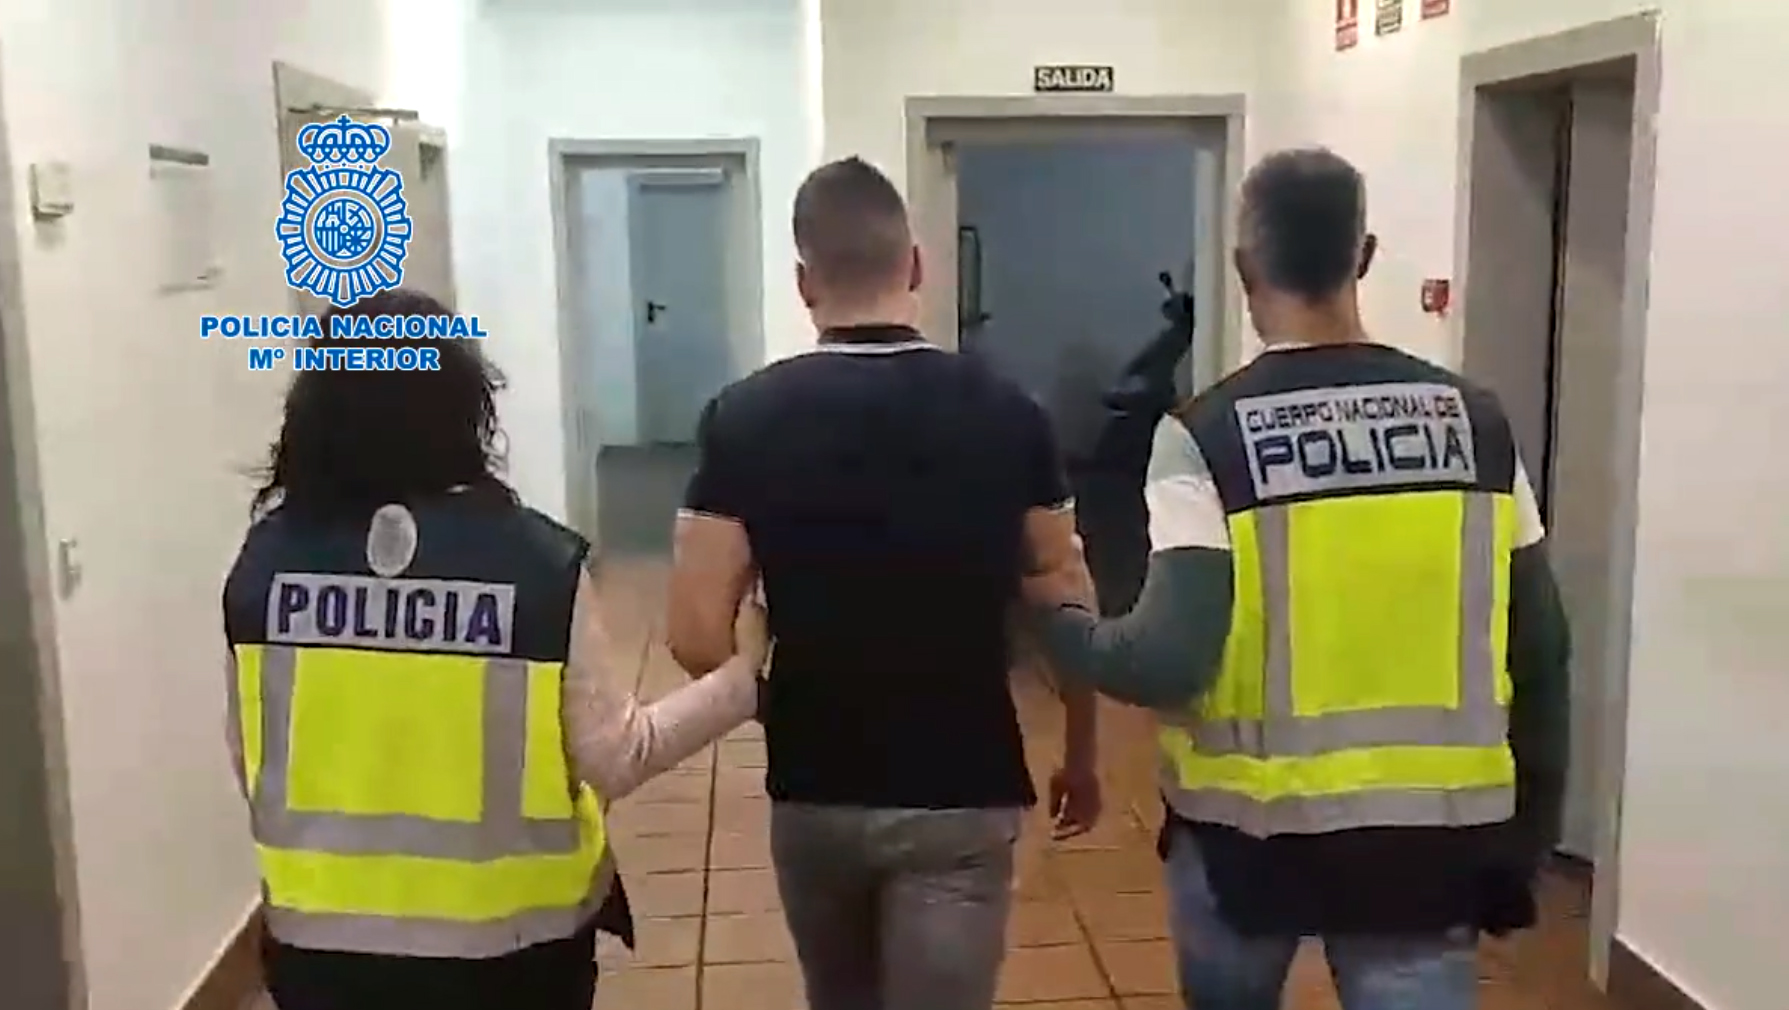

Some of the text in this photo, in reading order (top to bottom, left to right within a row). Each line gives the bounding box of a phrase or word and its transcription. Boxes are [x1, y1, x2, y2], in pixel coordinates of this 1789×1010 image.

[1037, 67, 1111, 90] SALIDA
[1246, 395, 1461, 433] CUERPO NACIONAL DE
[1253, 423, 1470, 485] POLICIA
[277, 582, 502, 646] POLICIA
